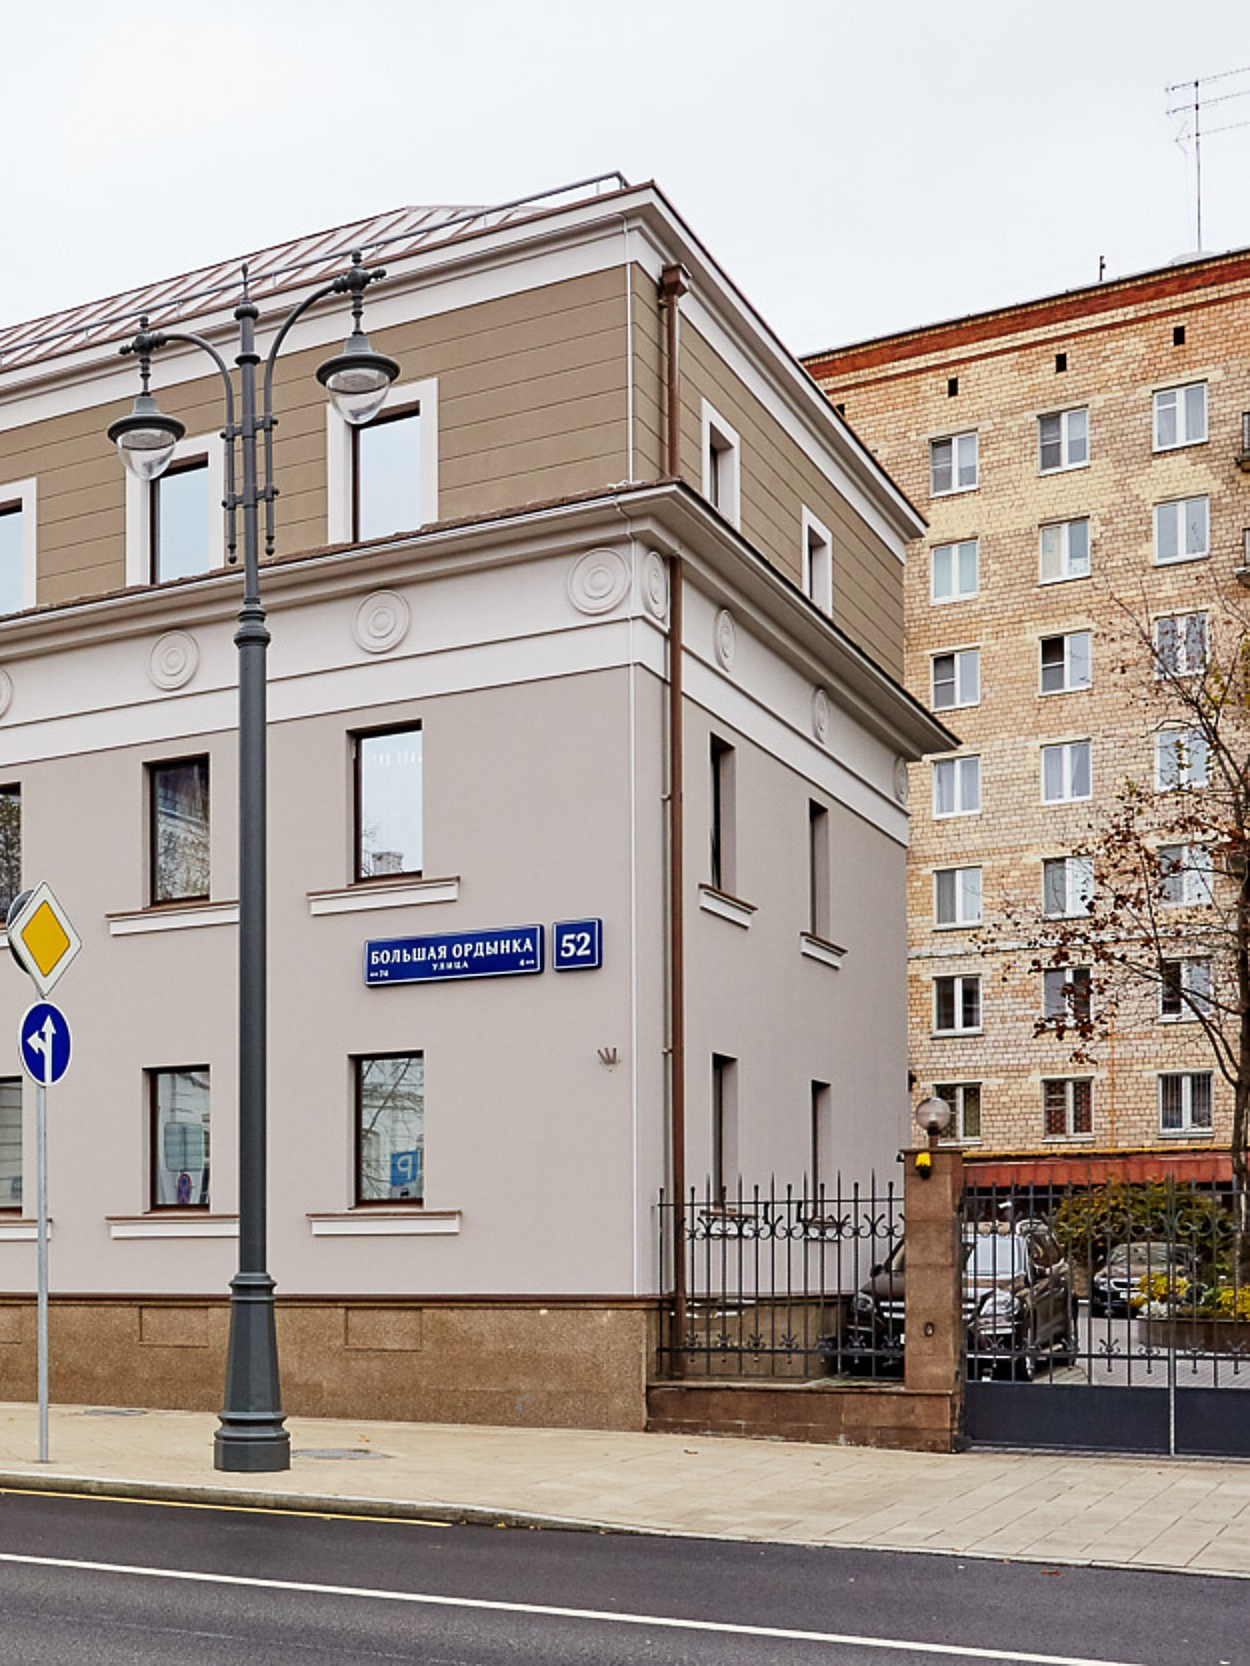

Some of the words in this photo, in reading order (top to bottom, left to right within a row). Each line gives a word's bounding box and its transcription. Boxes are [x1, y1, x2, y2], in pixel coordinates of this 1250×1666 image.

[371, 945, 447, 965] БОЛЬШАЯ
[452, 937, 533, 958] ОРДЫНКА
[560, 932, 591, 958] 52
[432, 961, 469, 971] УЛИЦА
